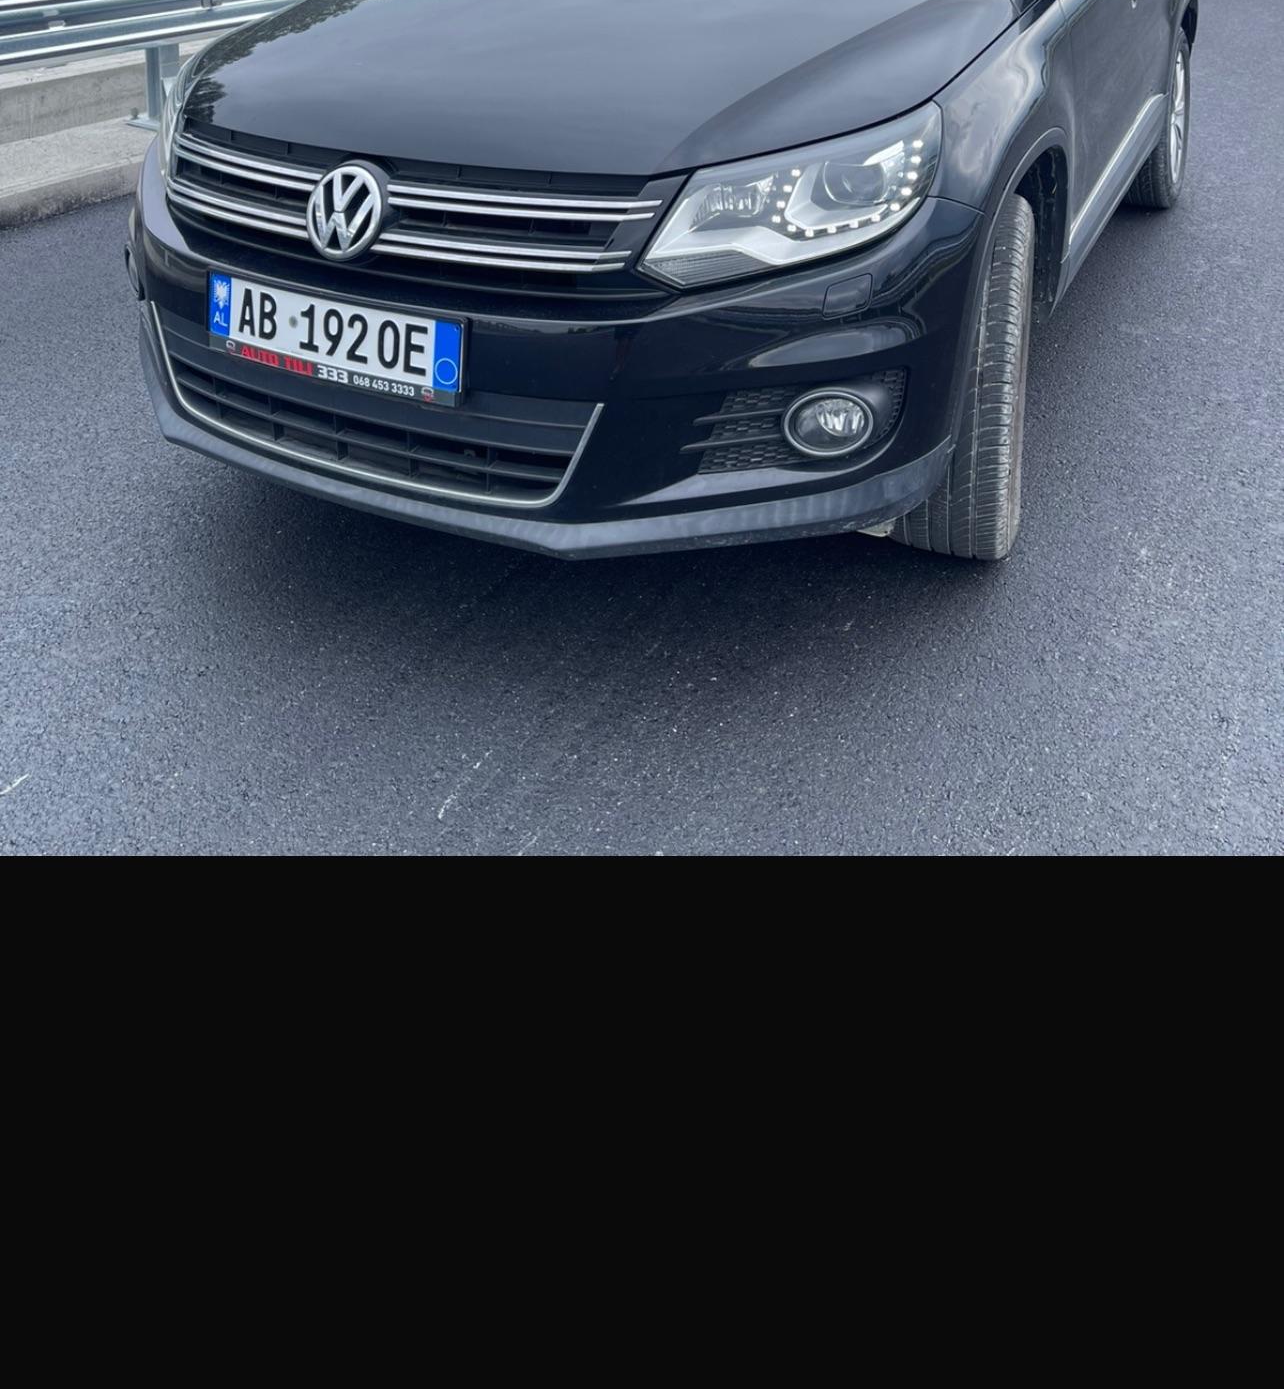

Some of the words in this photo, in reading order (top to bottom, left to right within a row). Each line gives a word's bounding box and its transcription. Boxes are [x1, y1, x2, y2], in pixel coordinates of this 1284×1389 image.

[308, 167, 380, 258] VW
[213, 310, 228, 327] AL
[238, 287, 277, 341] AB
[240, 345, 280, 367] AUTO
[317, 364, 349, 384] 333
[353, 374, 370, 388] 068
[372, 378, 390, 392] 453
[391, 382, 415, 397] 3333
